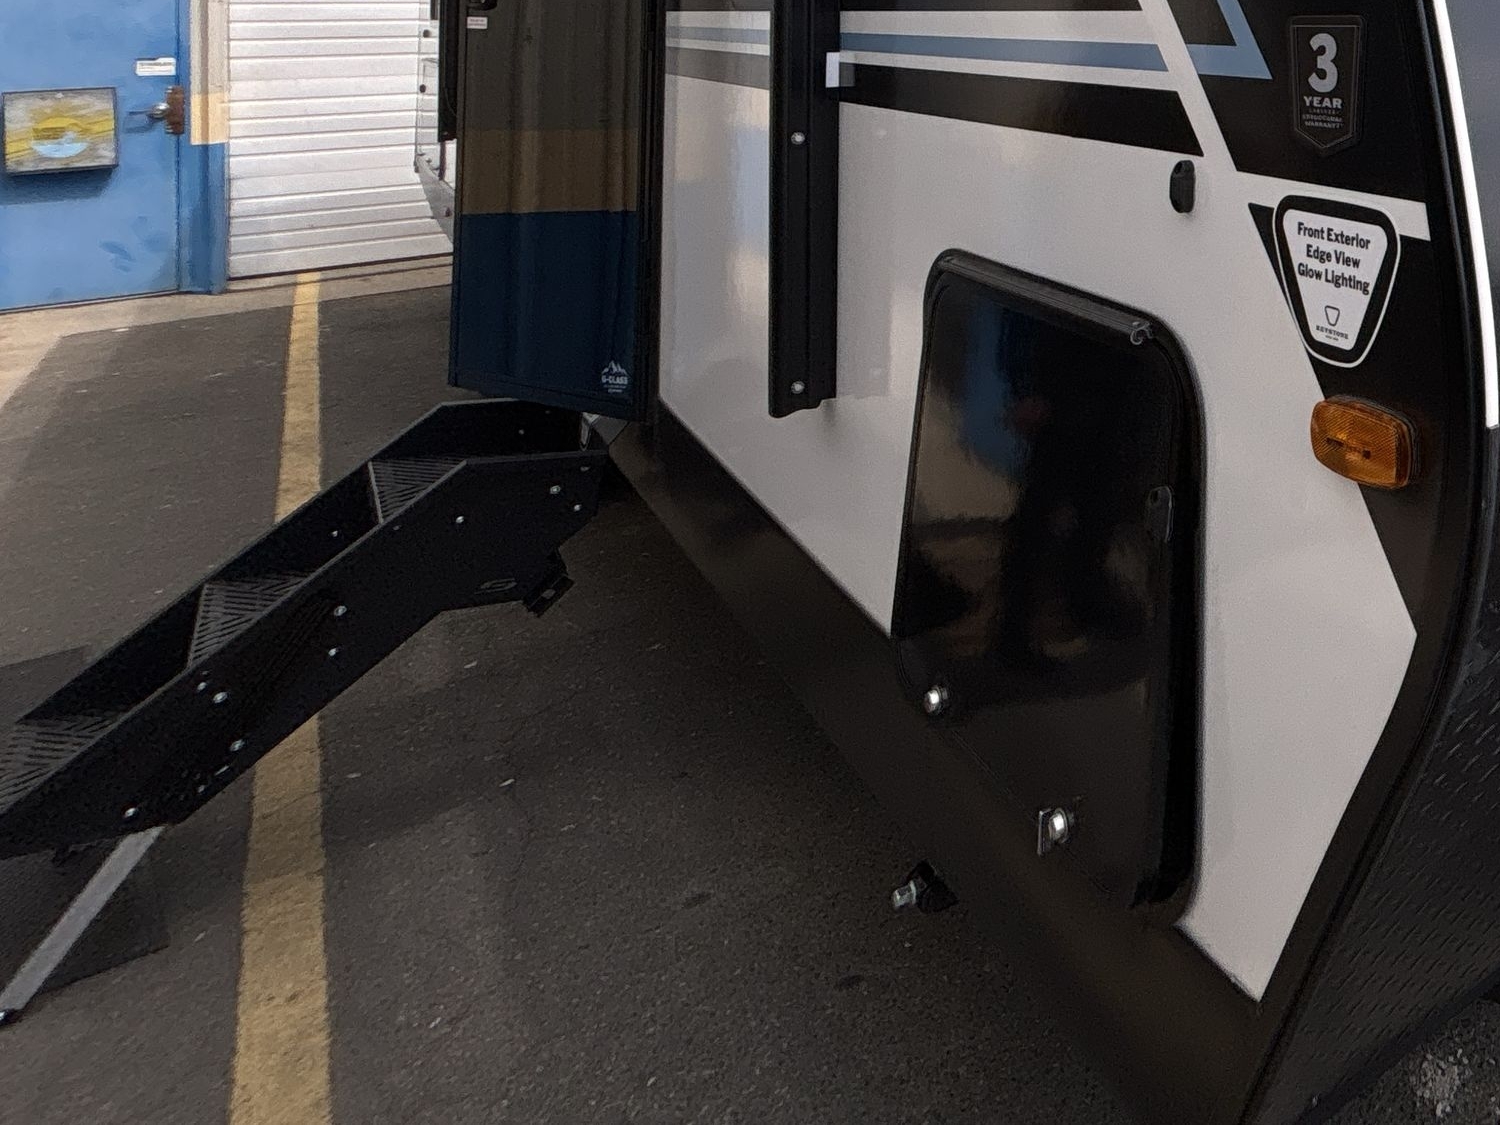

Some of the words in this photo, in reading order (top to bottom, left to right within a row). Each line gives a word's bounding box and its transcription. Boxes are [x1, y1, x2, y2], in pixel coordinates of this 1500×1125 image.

[1308, 33, 1338, 93] 3
[1303, 96, 1342, 109] YEAR
[1297, 221, 1325, 240] Front
[1326, 227, 1371, 250] Exterior
[1305, 244, 1332, 264] Edge
[1334, 249, 1361, 269] View
[1297, 262, 1323, 281] Glow
[1324, 268, 1370, 296] Lighting
[1315, 325, 1349, 340] KEYSTONE
